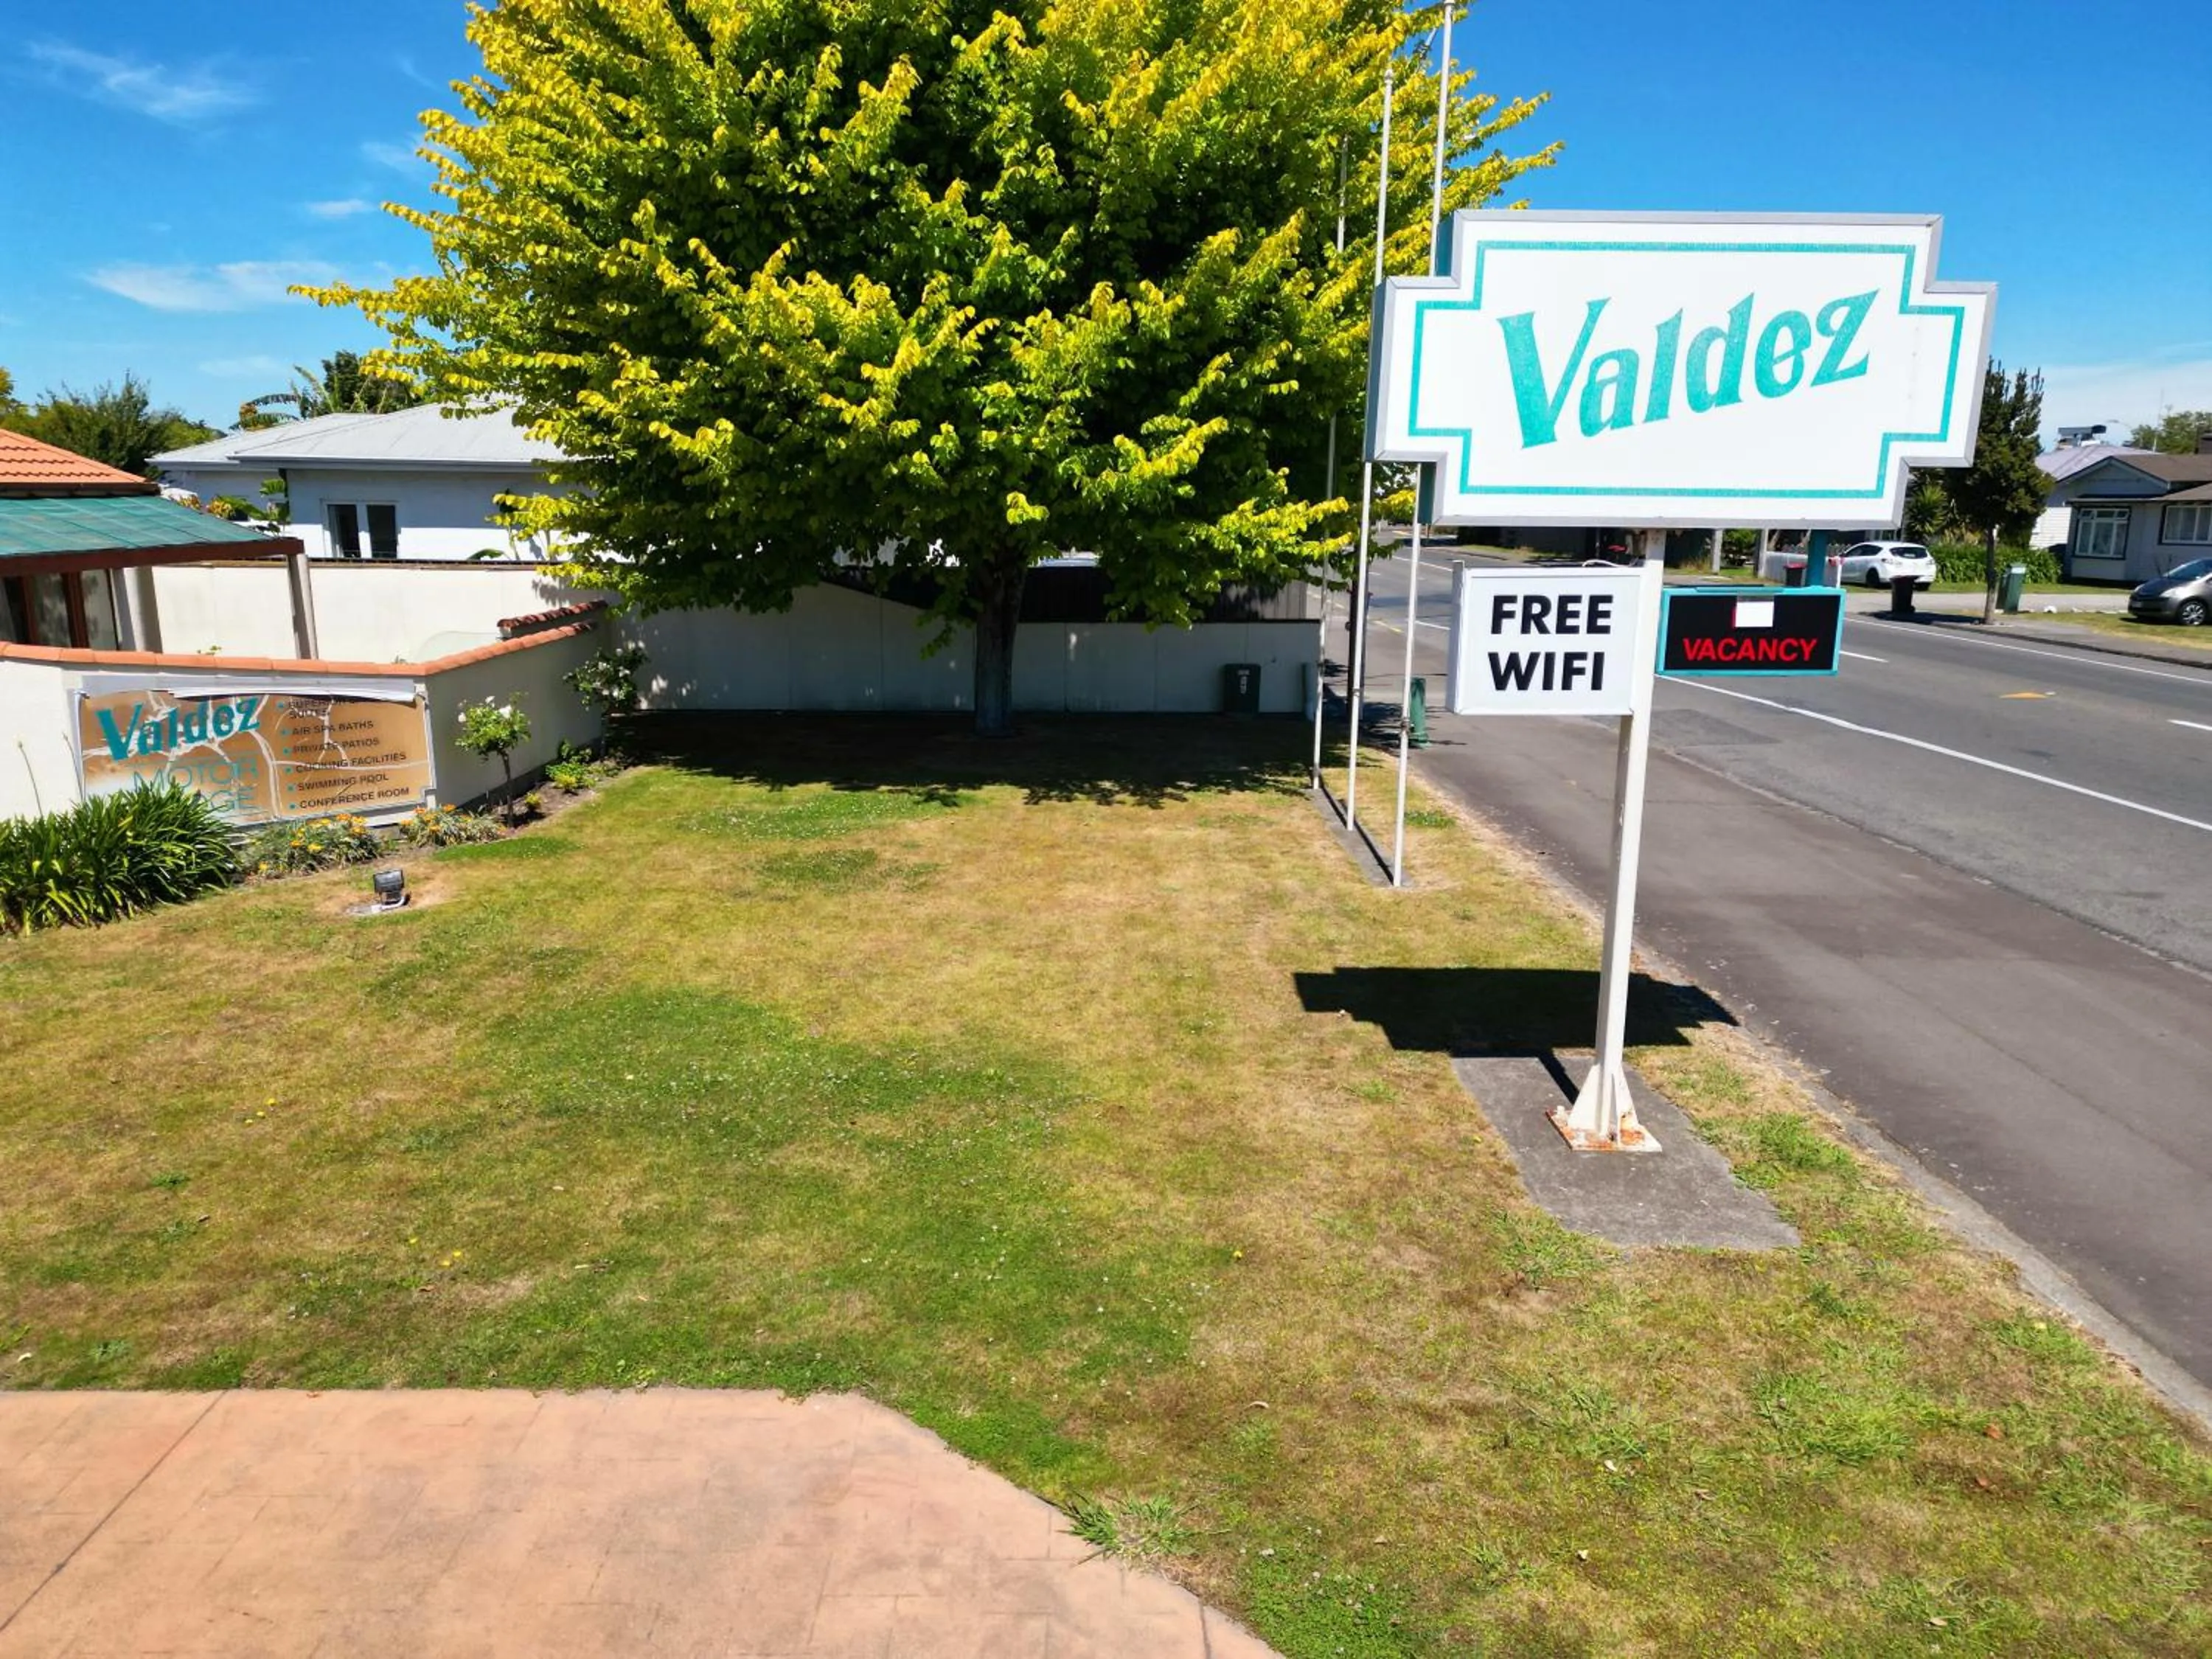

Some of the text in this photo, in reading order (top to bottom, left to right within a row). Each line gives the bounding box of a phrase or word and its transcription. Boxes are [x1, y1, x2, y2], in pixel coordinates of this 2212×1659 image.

[1498, 289, 1880, 449] Valdez
[1491, 594, 1613, 635] FREE
[1683, 638, 1818, 661] VACANCY
[1488, 651, 1605, 691] WIFI
[95, 697, 260, 762] Valdez
[292, 720, 374, 736] AIR SPA BATHS
[293, 737, 380, 754] PRIVATE PATIOS
[133, 757, 257, 792] MOTOR
[296, 753, 407, 773] COOKING FACILITIES
[297, 773, 389, 791] SWIMMING POOL
[300, 787, 410, 809] CONFERENCE ROOM
